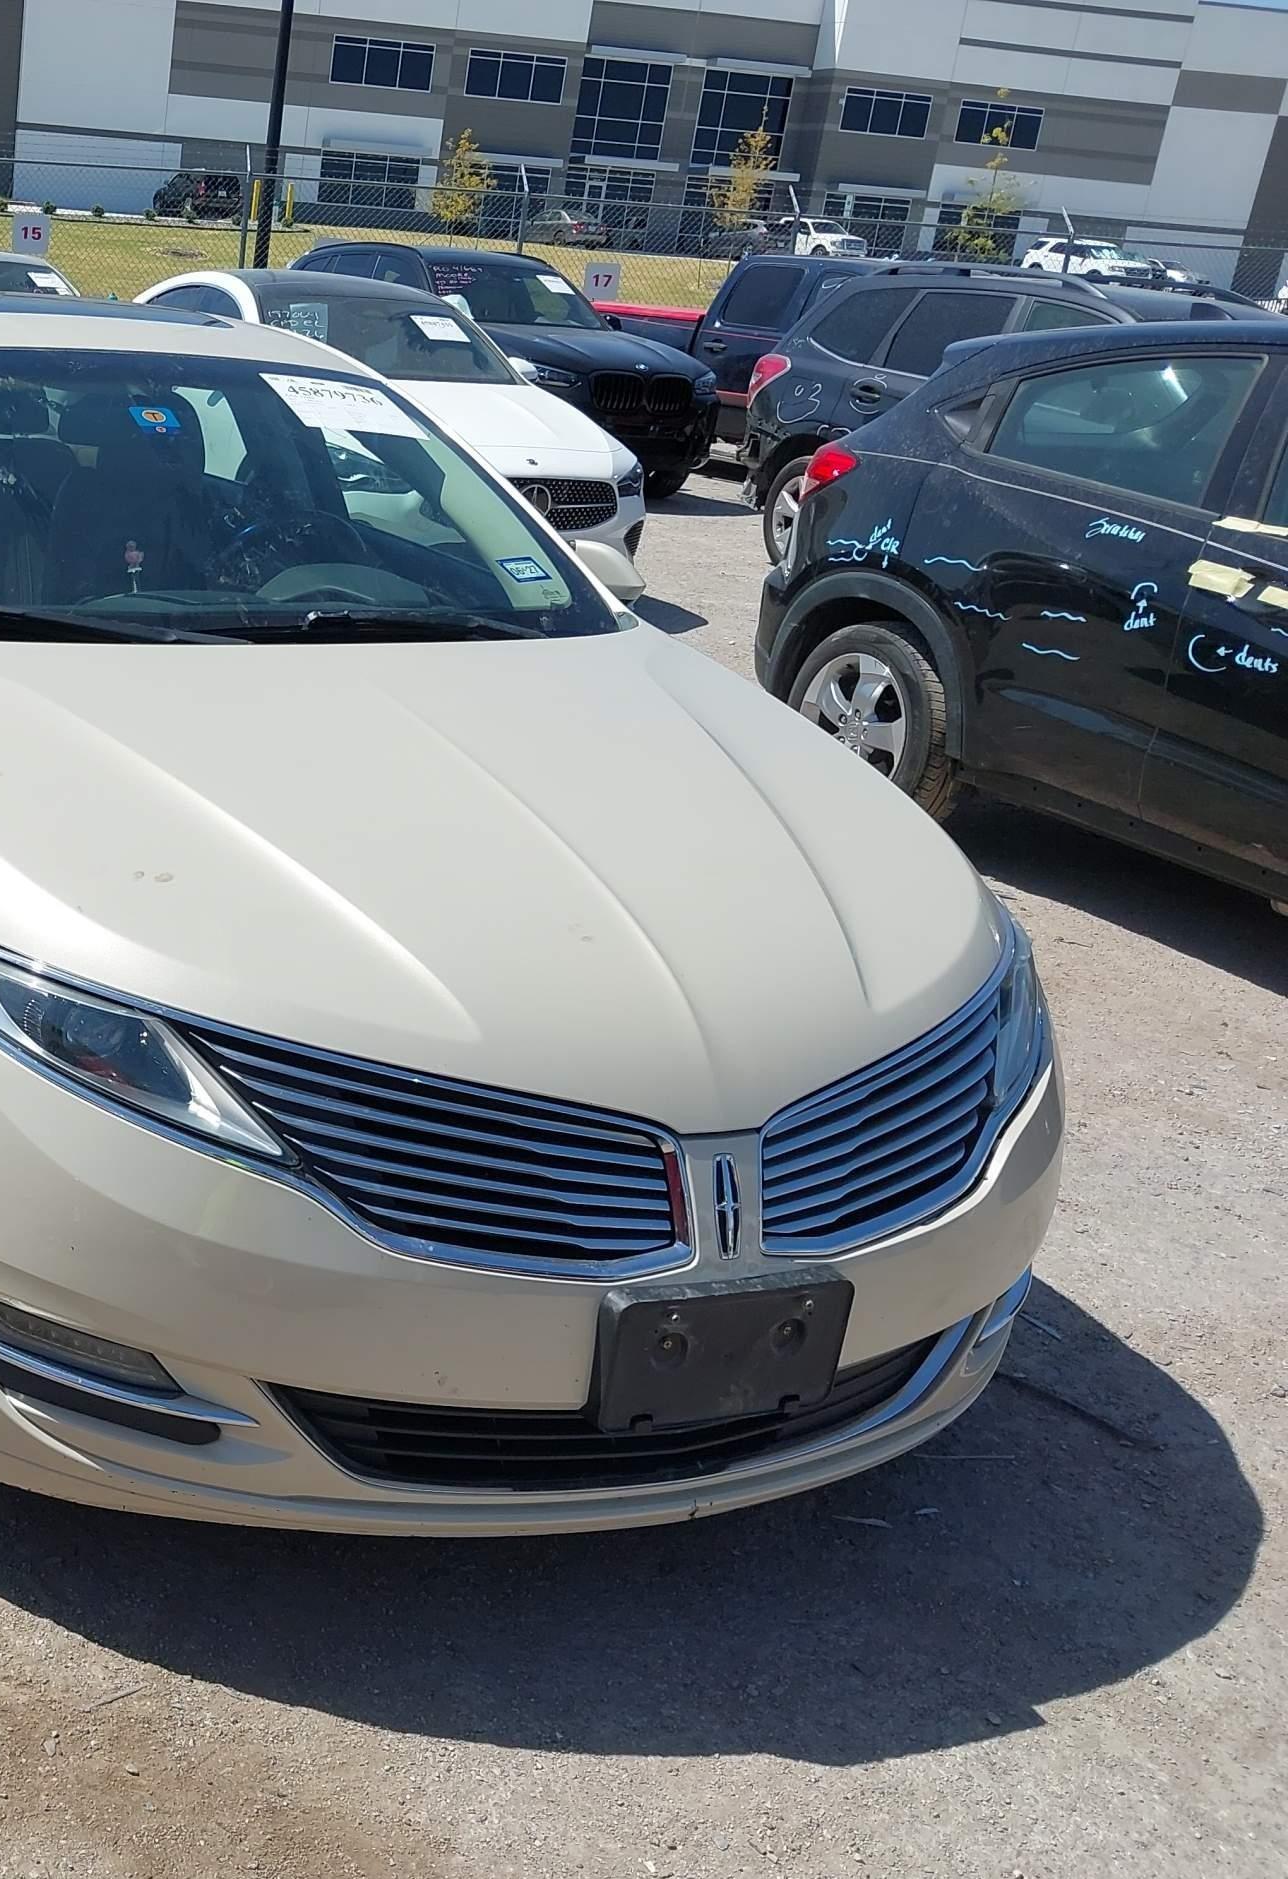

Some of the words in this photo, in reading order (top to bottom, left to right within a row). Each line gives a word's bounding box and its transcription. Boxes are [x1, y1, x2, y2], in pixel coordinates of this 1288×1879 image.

[21, 226, 42, 241] 15
[592, 274, 612, 287] 17
[287, 385, 383, 406] 45879736
[1123, 611, 1157, 631] dent
[1235, 644, 1279, 673] dents
